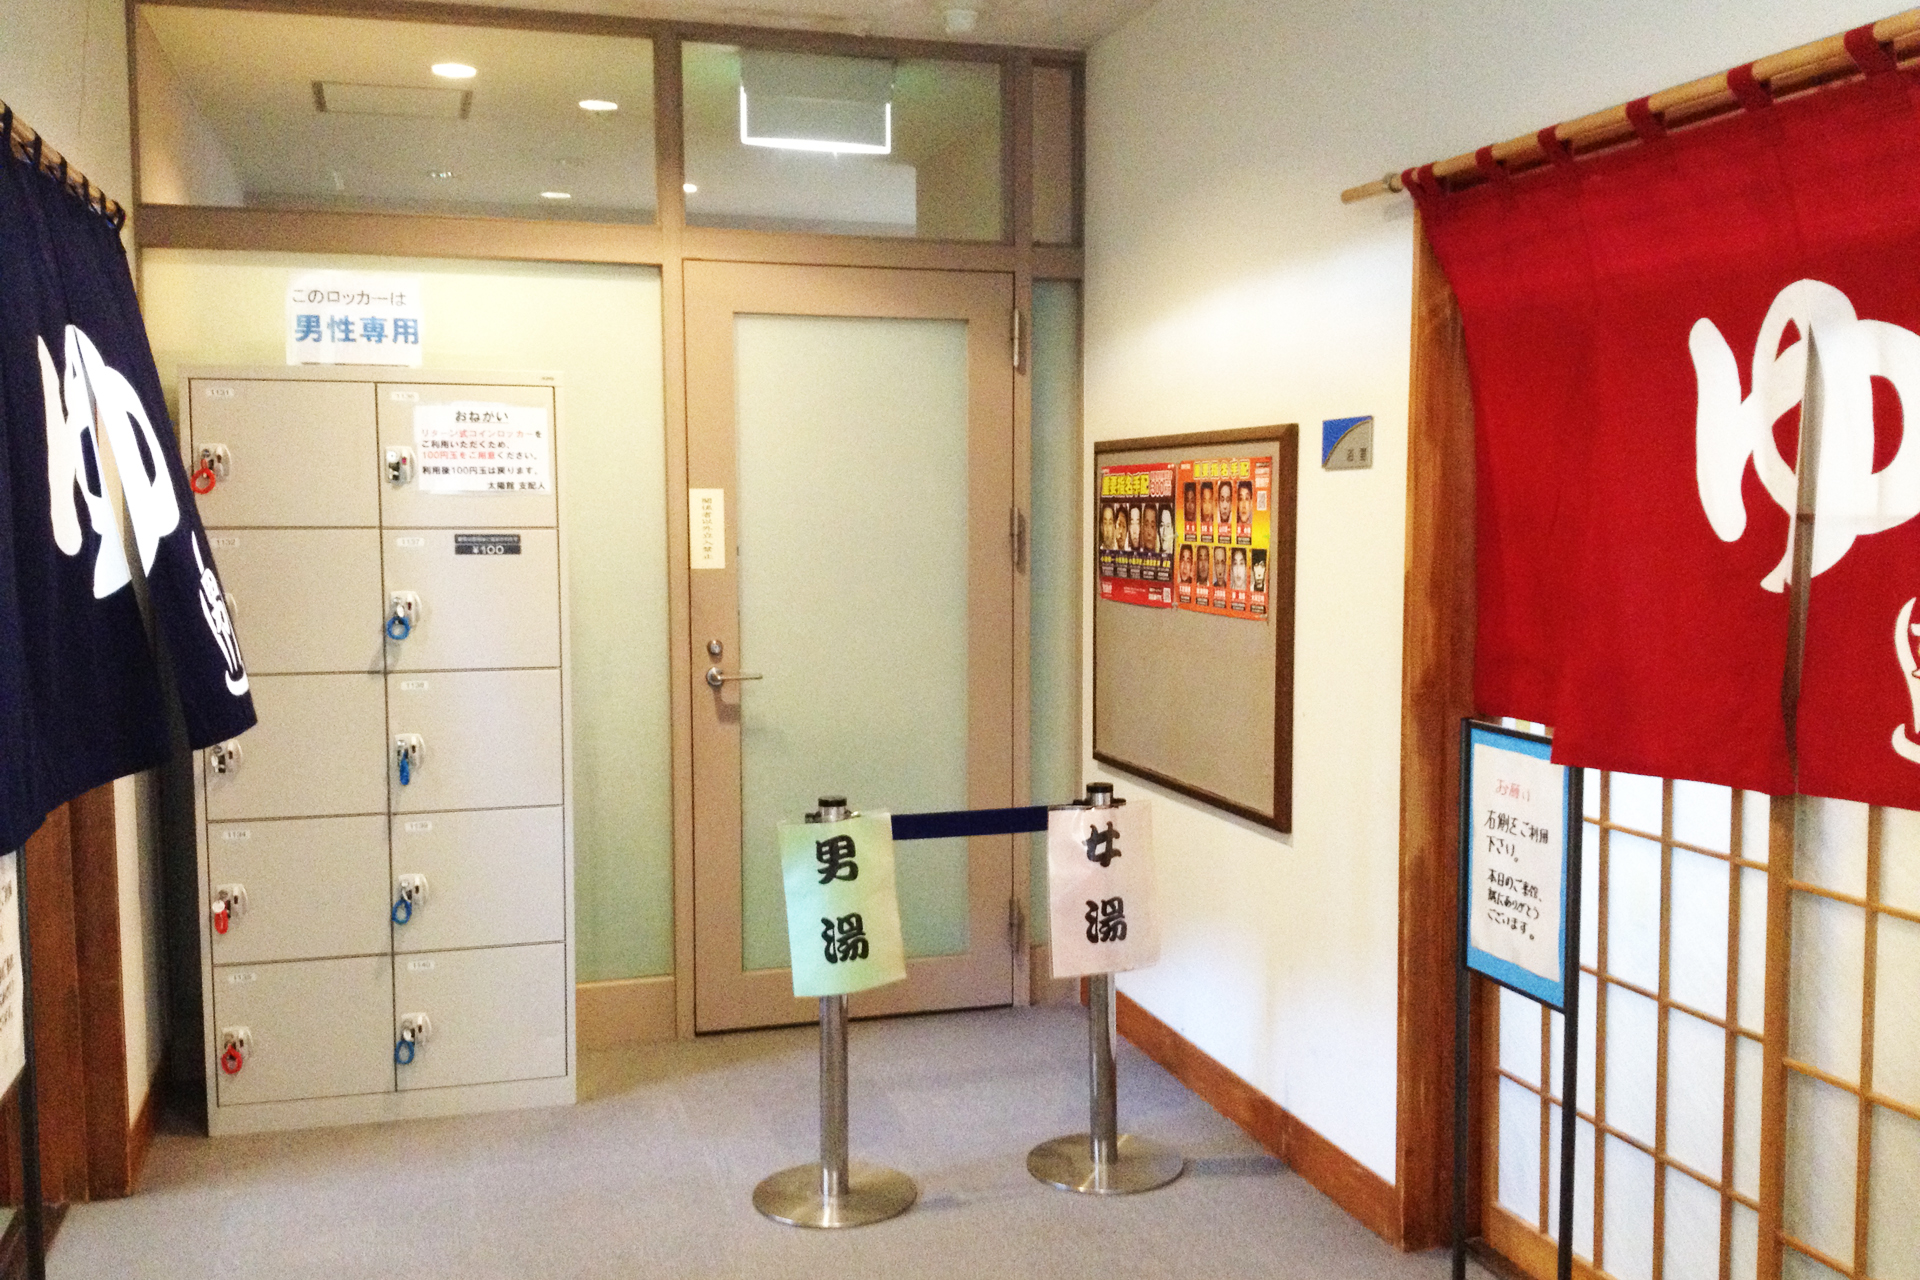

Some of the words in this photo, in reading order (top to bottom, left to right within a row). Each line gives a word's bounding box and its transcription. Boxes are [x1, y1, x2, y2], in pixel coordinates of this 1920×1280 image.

[292, 288, 407, 306] このロッカーは
[294, 314, 419, 344] 男性専用
[455, 410, 509, 422] おねがい
[422, 429, 542, 438] リターン式コインロッカーを
[1688, 278, 1920, 593] ゆ
[422, 440, 510, 449] ご利用いただくため、
[37, 324, 180, 599] ゆ
[422, 451, 538, 460] 100円玉をご用意ください。
[422, 466, 538, 475] 利用後100円玉は戻ります。
[1082, 821, 1128, 943] 女湯
[815, 834, 870, 964] 男湯
